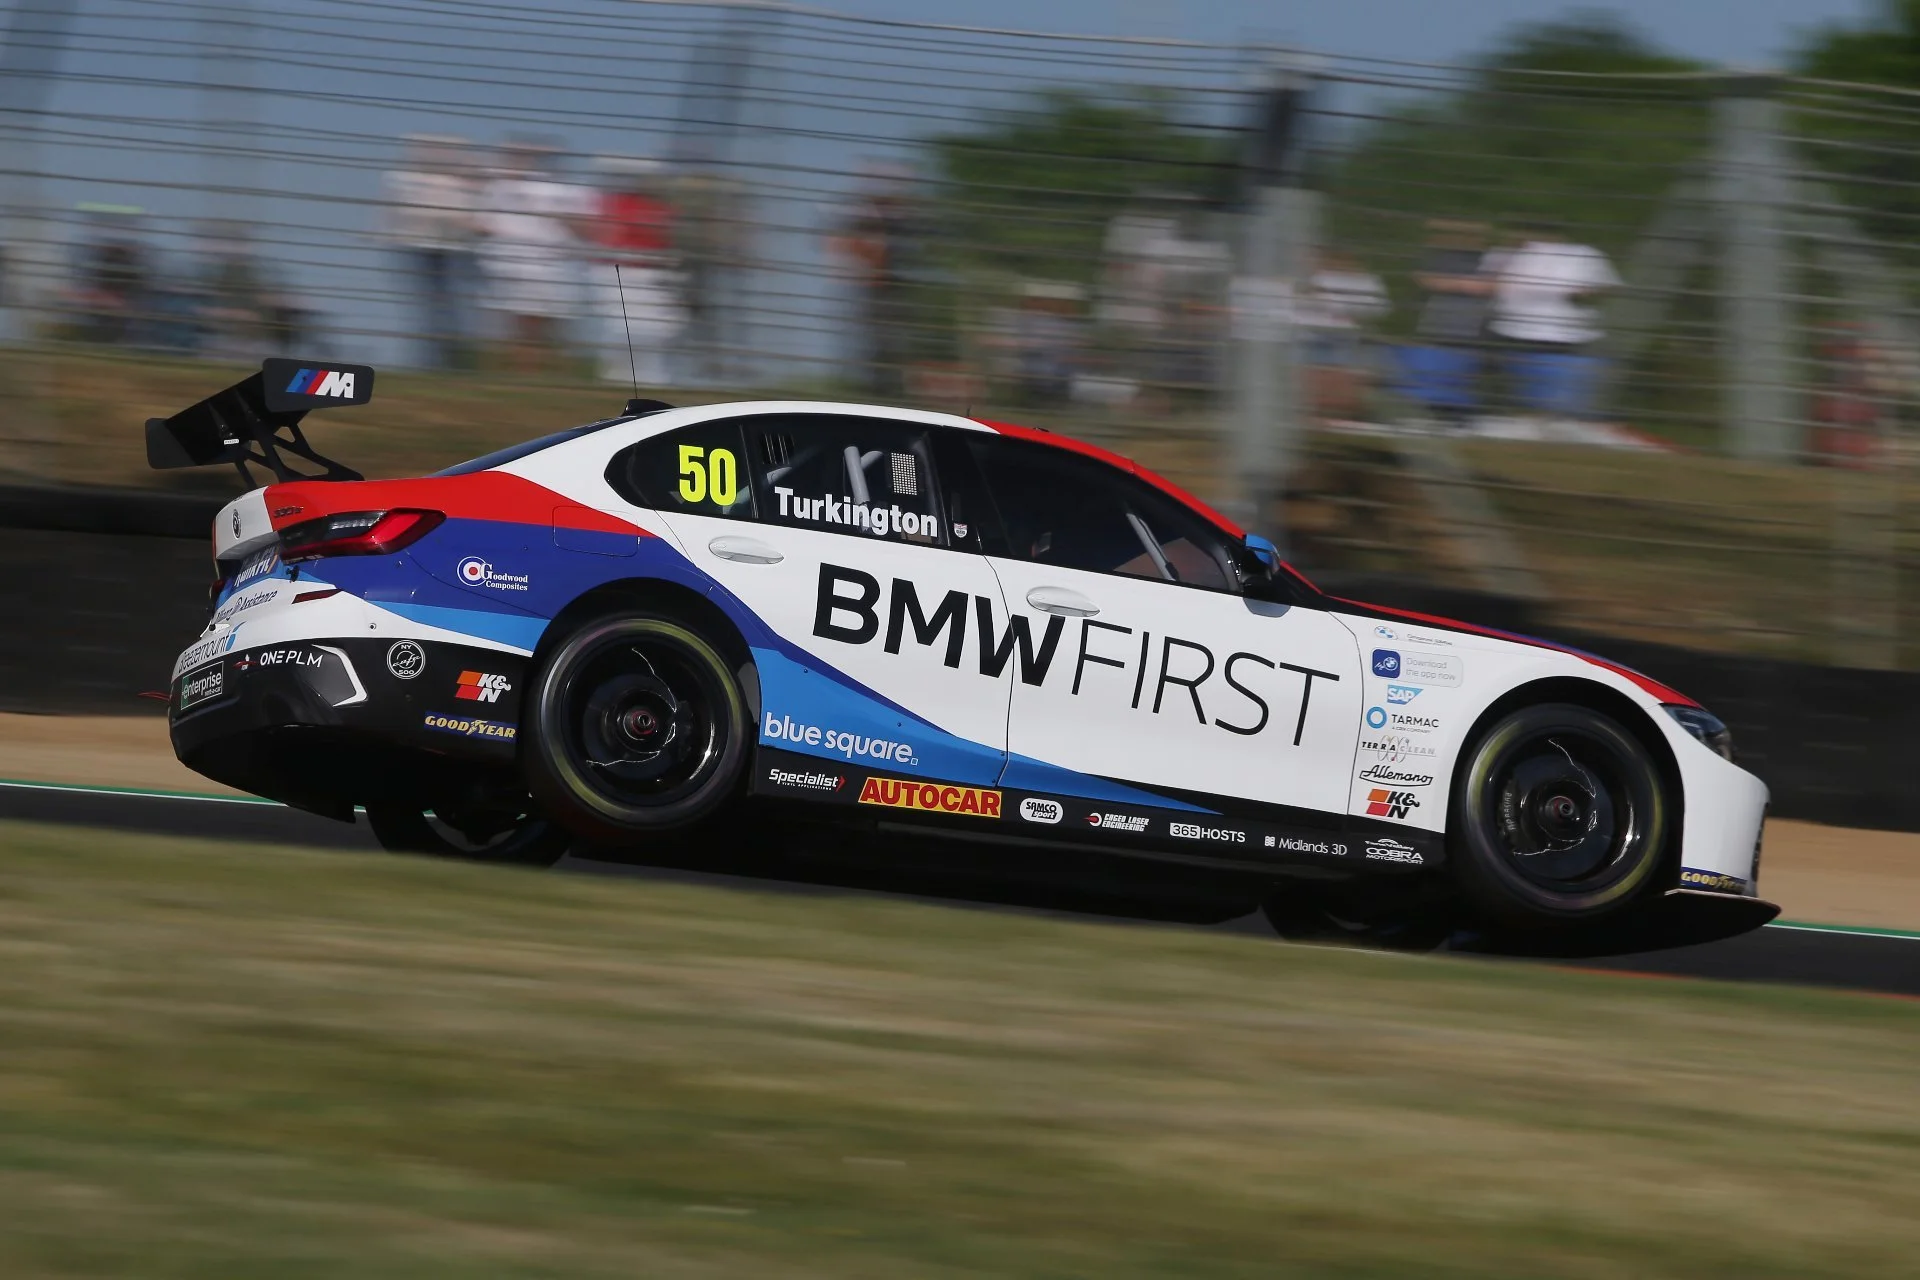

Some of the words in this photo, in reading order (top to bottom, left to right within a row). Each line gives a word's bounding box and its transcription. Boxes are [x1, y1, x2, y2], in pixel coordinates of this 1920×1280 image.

[678, 444, 737, 506] 50
[774, 486, 938, 538] Turkington
[480, 563, 528, 583] Goodwood
[485, 580, 528, 591] Composites
[1406, 658, 1447, 669] Download
[1406, 669, 1419, 677] the
[1420, 671, 1437, 680] app
[1438, 673, 1456, 681] now
[183, 671, 222, 699] enterprise
[1387, 687, 1416, 701] SAP
[424, 715, 516, 738] GOODYEAR
[1391, 714, 1440, 728] TARMAC
[764, 712, 822, 745] blue
[769, 768, 839, 788] Specialist
[861, 778, 1000, 817] AUTOCAR
[1025, 801, 1057, 814] SAMCO
[1032, 810, 1058, 820] sport
[1101, 821, 1146, 832] ENGINEERING
[1279, 837, 1329, 855] Midlands
[1331, 843, 1348, 856] 3D
[1365, 854, 1425, 865] MOTORSPORT
[1366, 847, 1425, 861] COBRA
